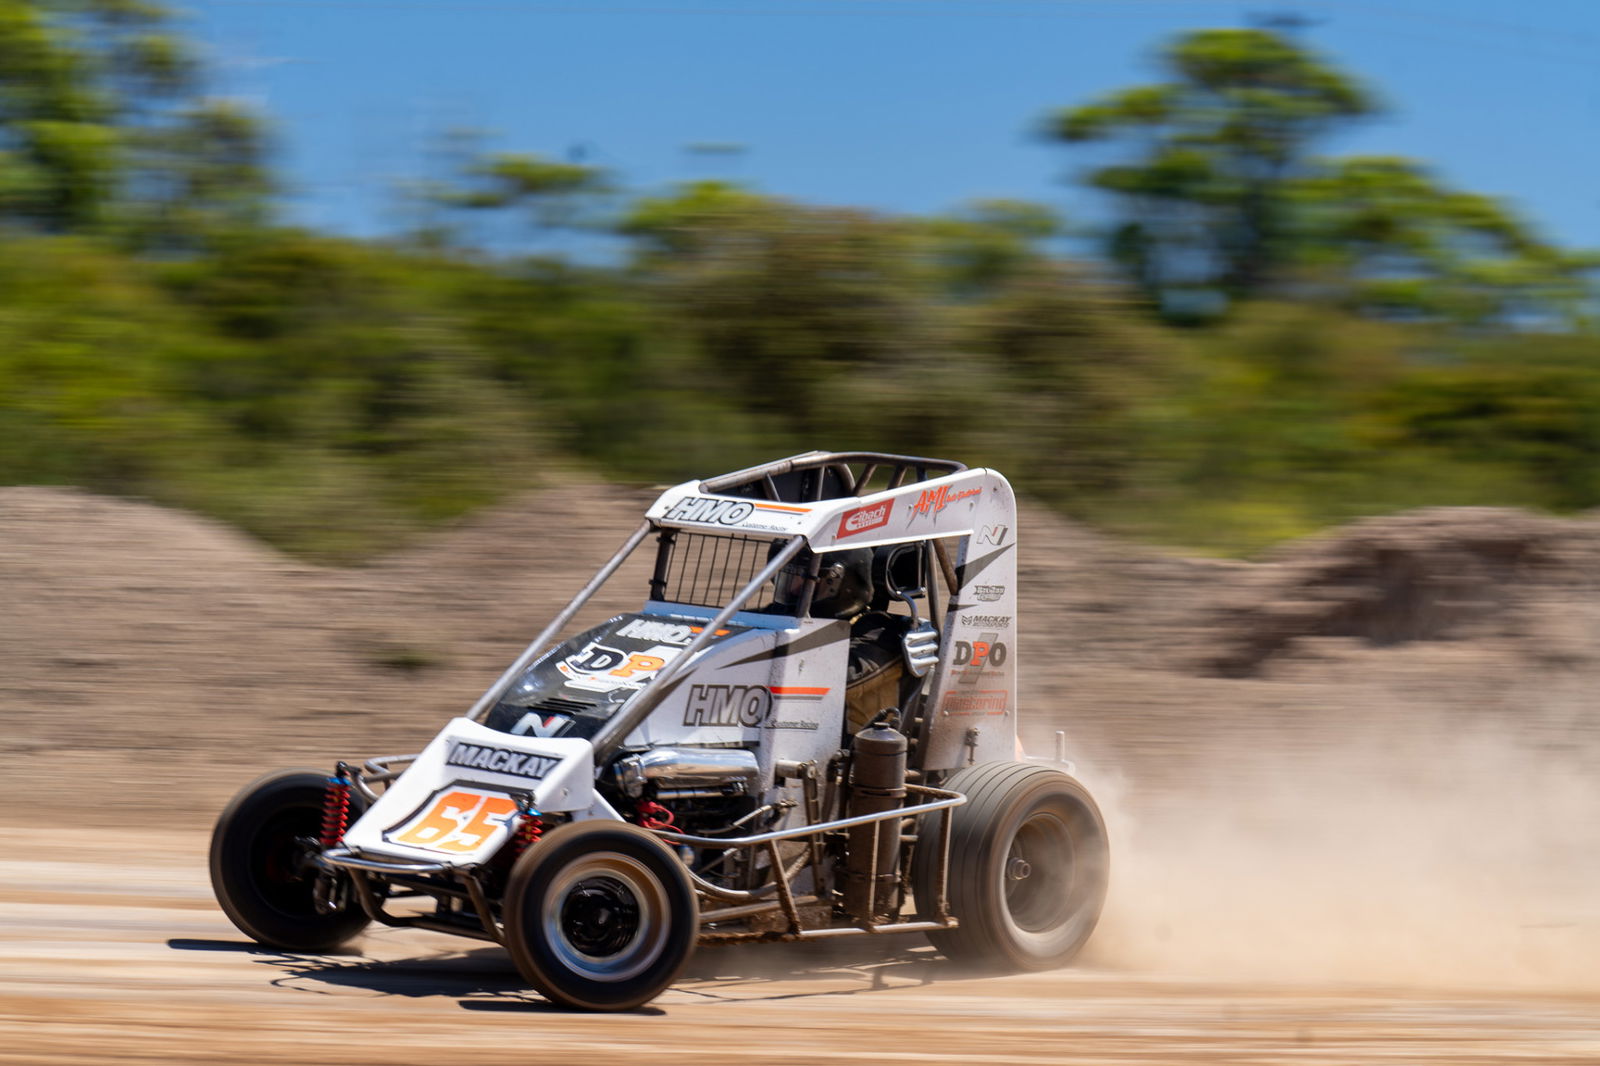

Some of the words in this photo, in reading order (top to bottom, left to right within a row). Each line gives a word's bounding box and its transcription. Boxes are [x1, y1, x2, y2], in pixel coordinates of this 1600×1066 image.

[663, 496, 754, 525] HMO
[616, 618, 692, 645] HMO
[973, 615, 1012, 623] MACKAY
[565, 645, 667, 677] DP
[953, 641, 1006, 667] DPO
[683, 685, 772, 728] HMO
[450, 743, 558, 779] MACKAY
[396, 791, 518, 852] 65
